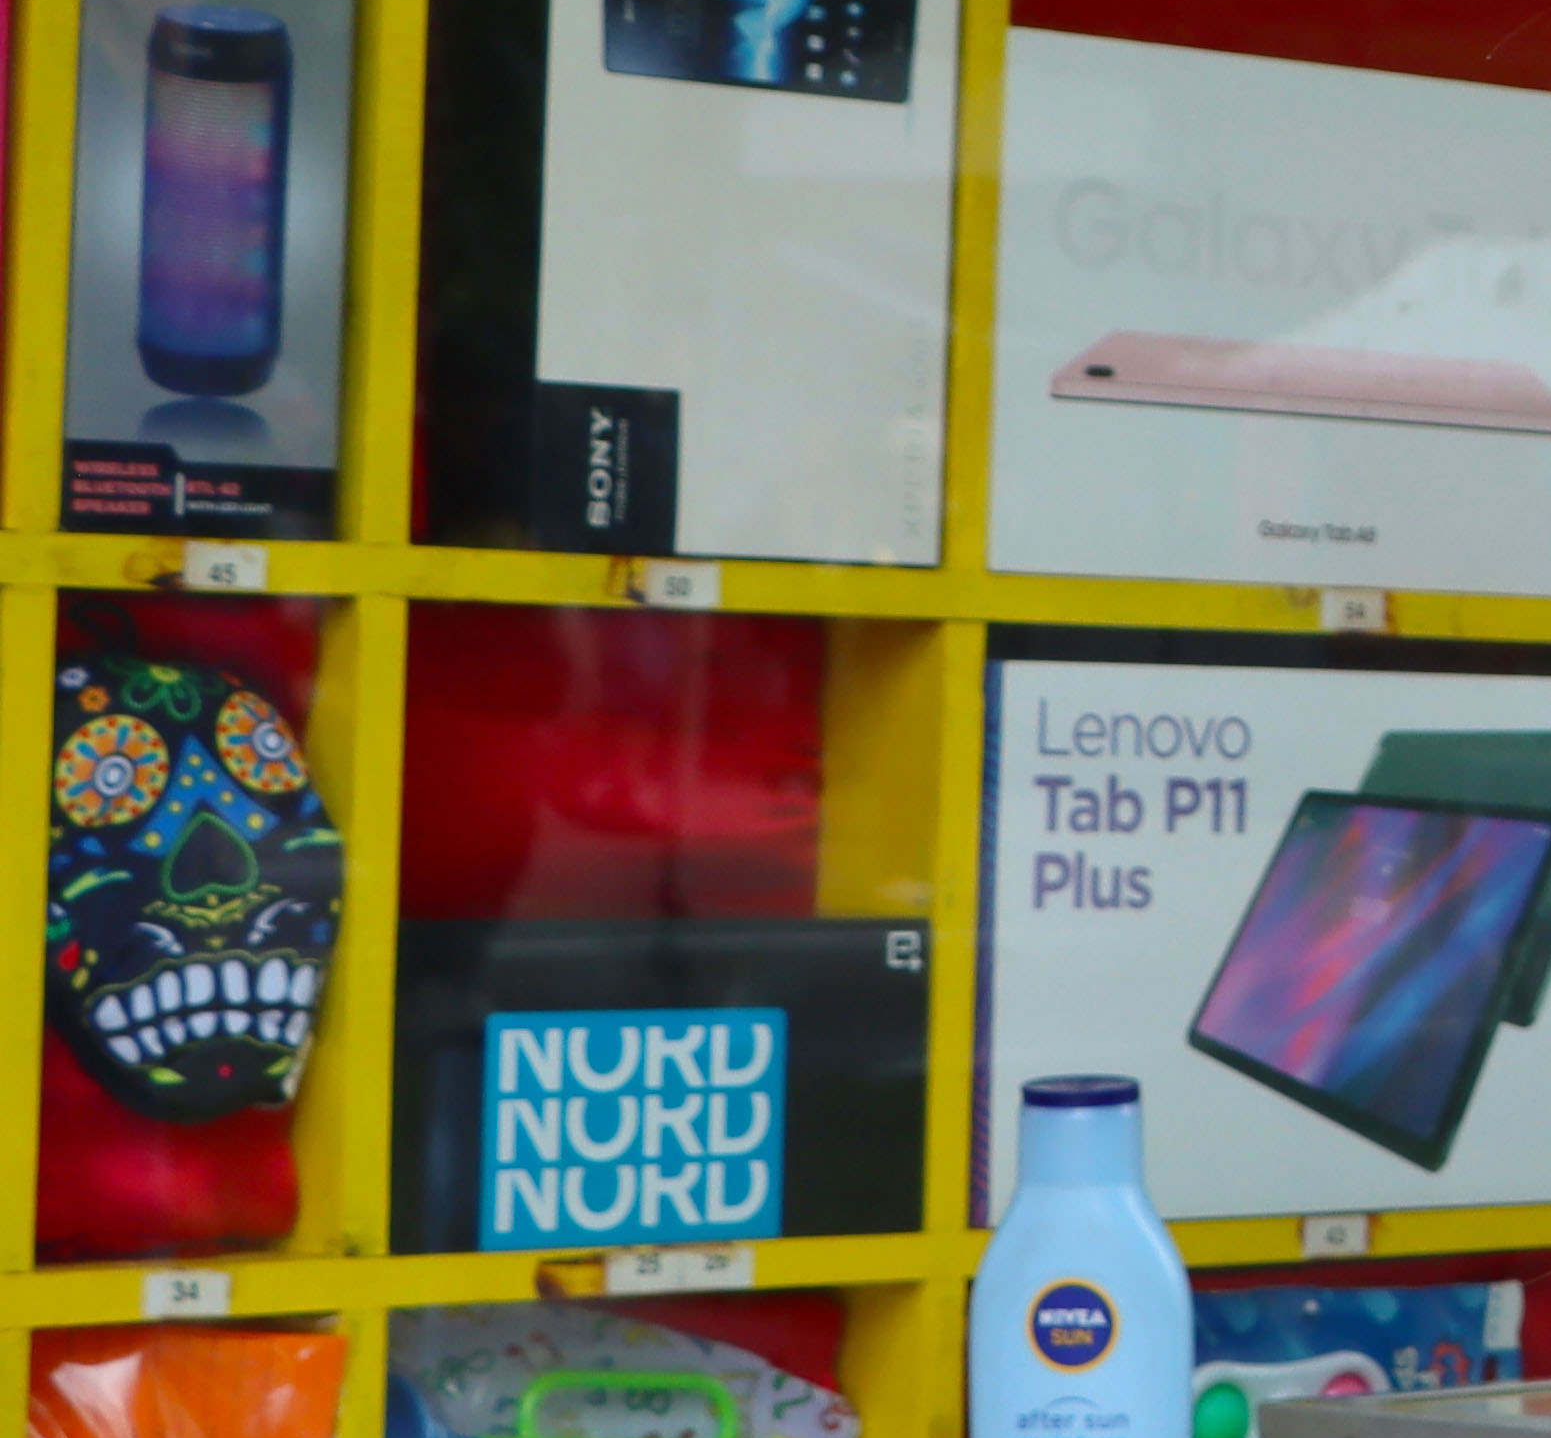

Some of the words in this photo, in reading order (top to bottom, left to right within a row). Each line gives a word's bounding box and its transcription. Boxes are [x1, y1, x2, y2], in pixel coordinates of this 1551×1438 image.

[587, 408, 614, 528] SONY
[208, 563, 238, 586] 45
[1037, 696, 1252, 760] Lenovo
[1033, 773, 1145, 834] Tab
[1165, 775, 1248, 834] P11
[1033, 851, 1153, 910] Plus
[171, 1279, 200, 1302] 34
[1038, 1307, 1108, 1328] NIVEA
[1050, 1327, 1095, 1347] SUN
[1016, 1409, 1075, 1431] after
[1083, 1413, 1130, 1431] sun
